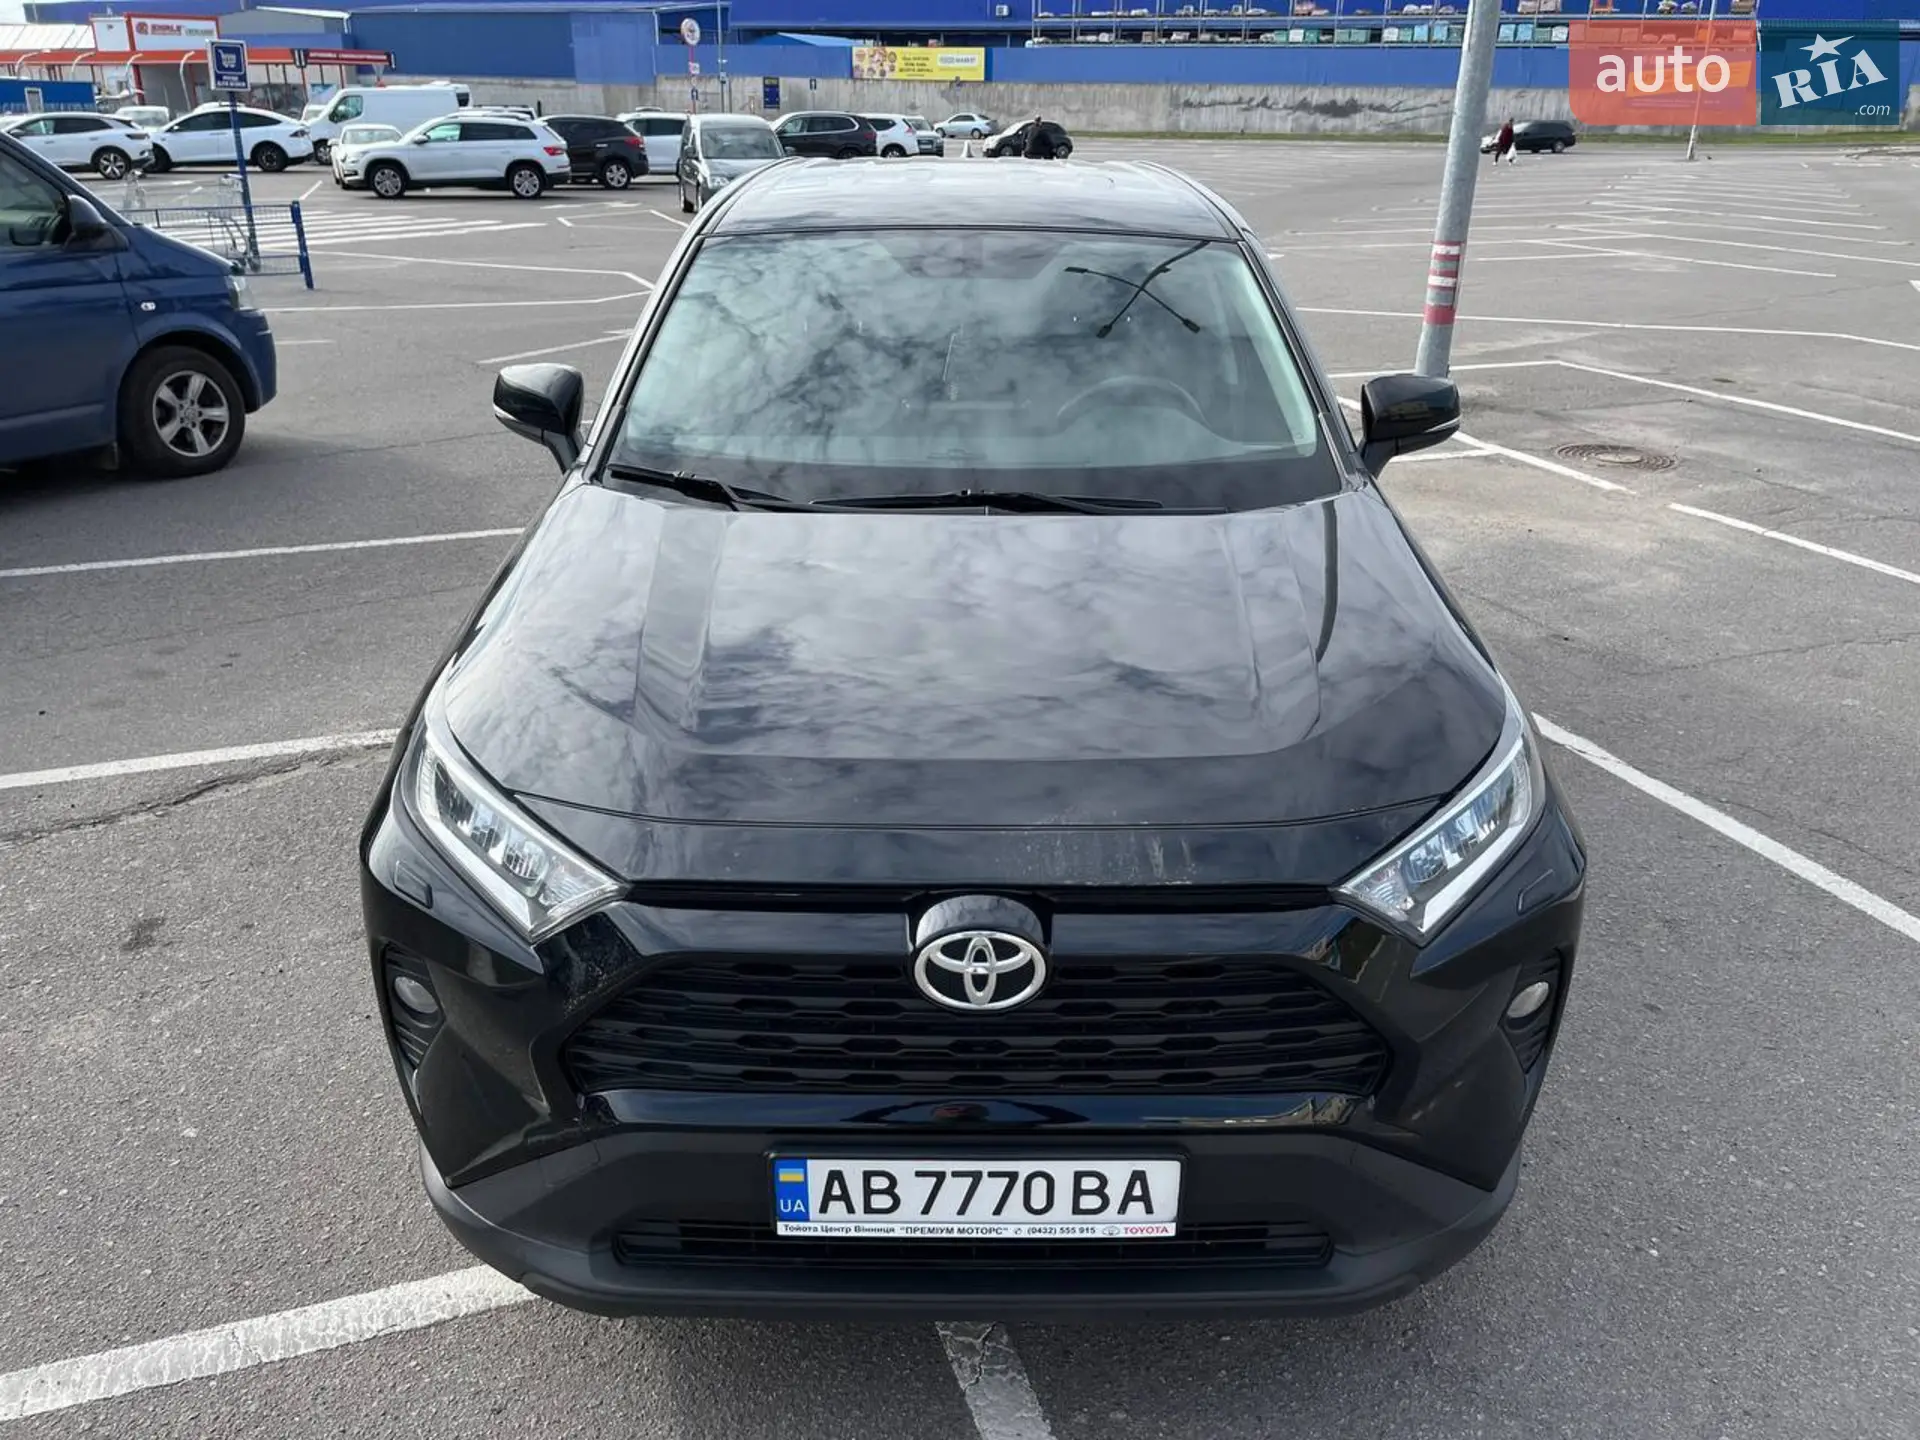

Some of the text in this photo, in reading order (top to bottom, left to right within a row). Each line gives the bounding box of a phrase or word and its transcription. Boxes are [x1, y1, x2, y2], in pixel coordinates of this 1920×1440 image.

[818, 1169, 1154, 1216] AB 7770 BA
[779, 1200, 806, 1213] UA
[784, 1223, 819, 1233] Тойота
[820, 1224, 852, 1235] Центр
[854, 1225, 895, 1235] Вінниця
[1027, 1225, 1057, 1236] (0432)
[1059, 1226, 1077, 1235] 555
[1078, 1226, 1096, 1235] 915
[1124, 1225, 1169, 1235] TOYOTA
